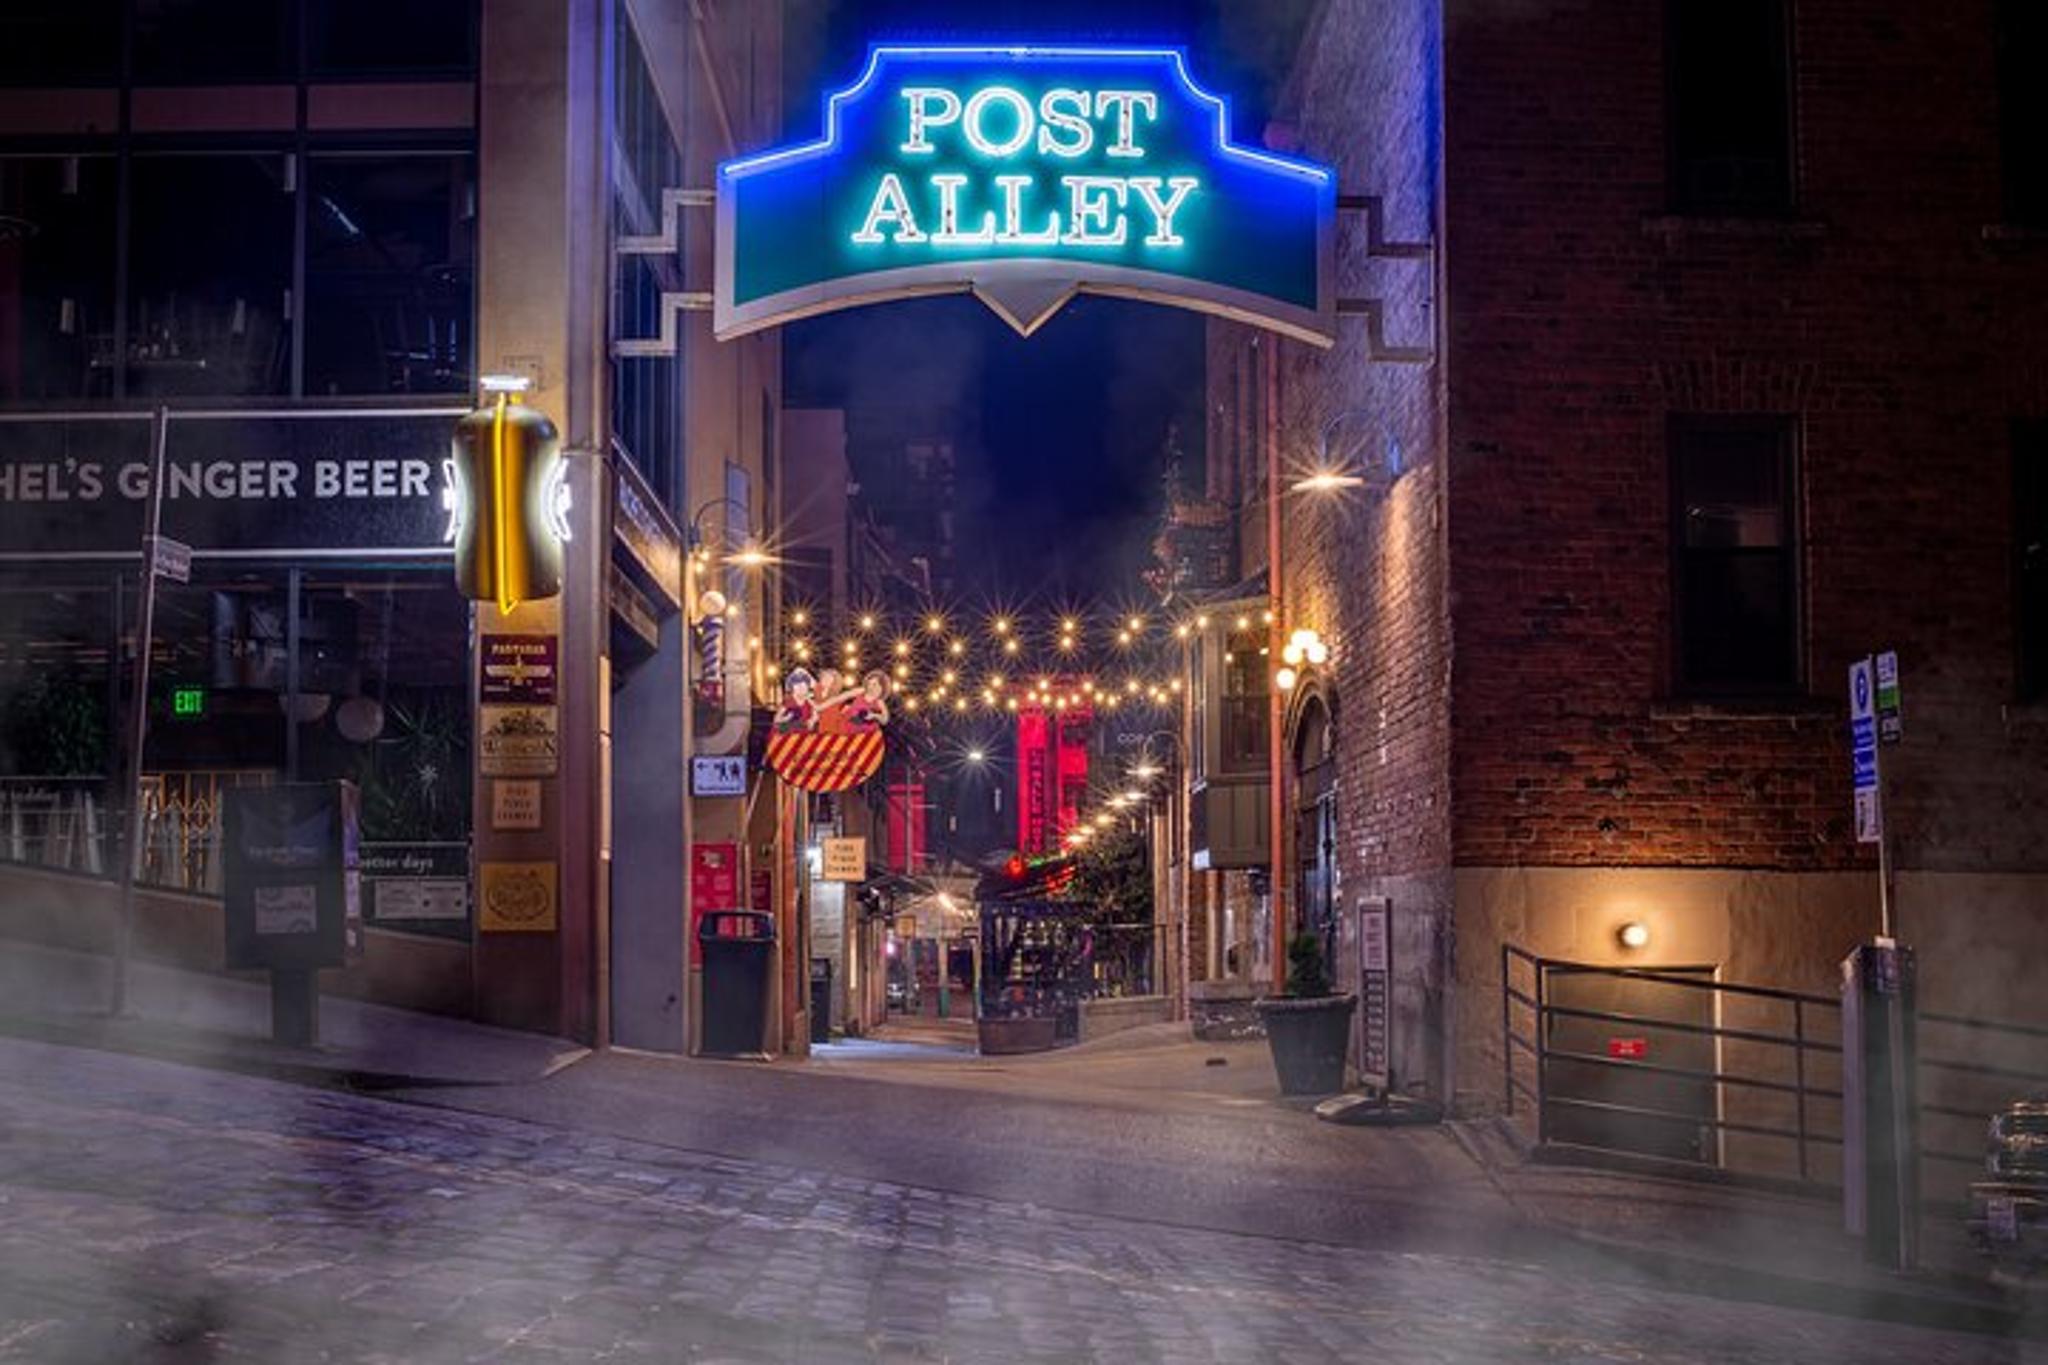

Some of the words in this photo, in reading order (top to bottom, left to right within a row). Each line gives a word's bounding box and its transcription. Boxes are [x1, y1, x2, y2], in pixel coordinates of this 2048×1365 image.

[900, 86, 1158, 159] POST
[850, 172, 1199, 247] ALLEY
[117, 461, 299, 500] GNGER
[315, 459, 431, 498] BEER
[175, 690, 203, 713] EXIT
